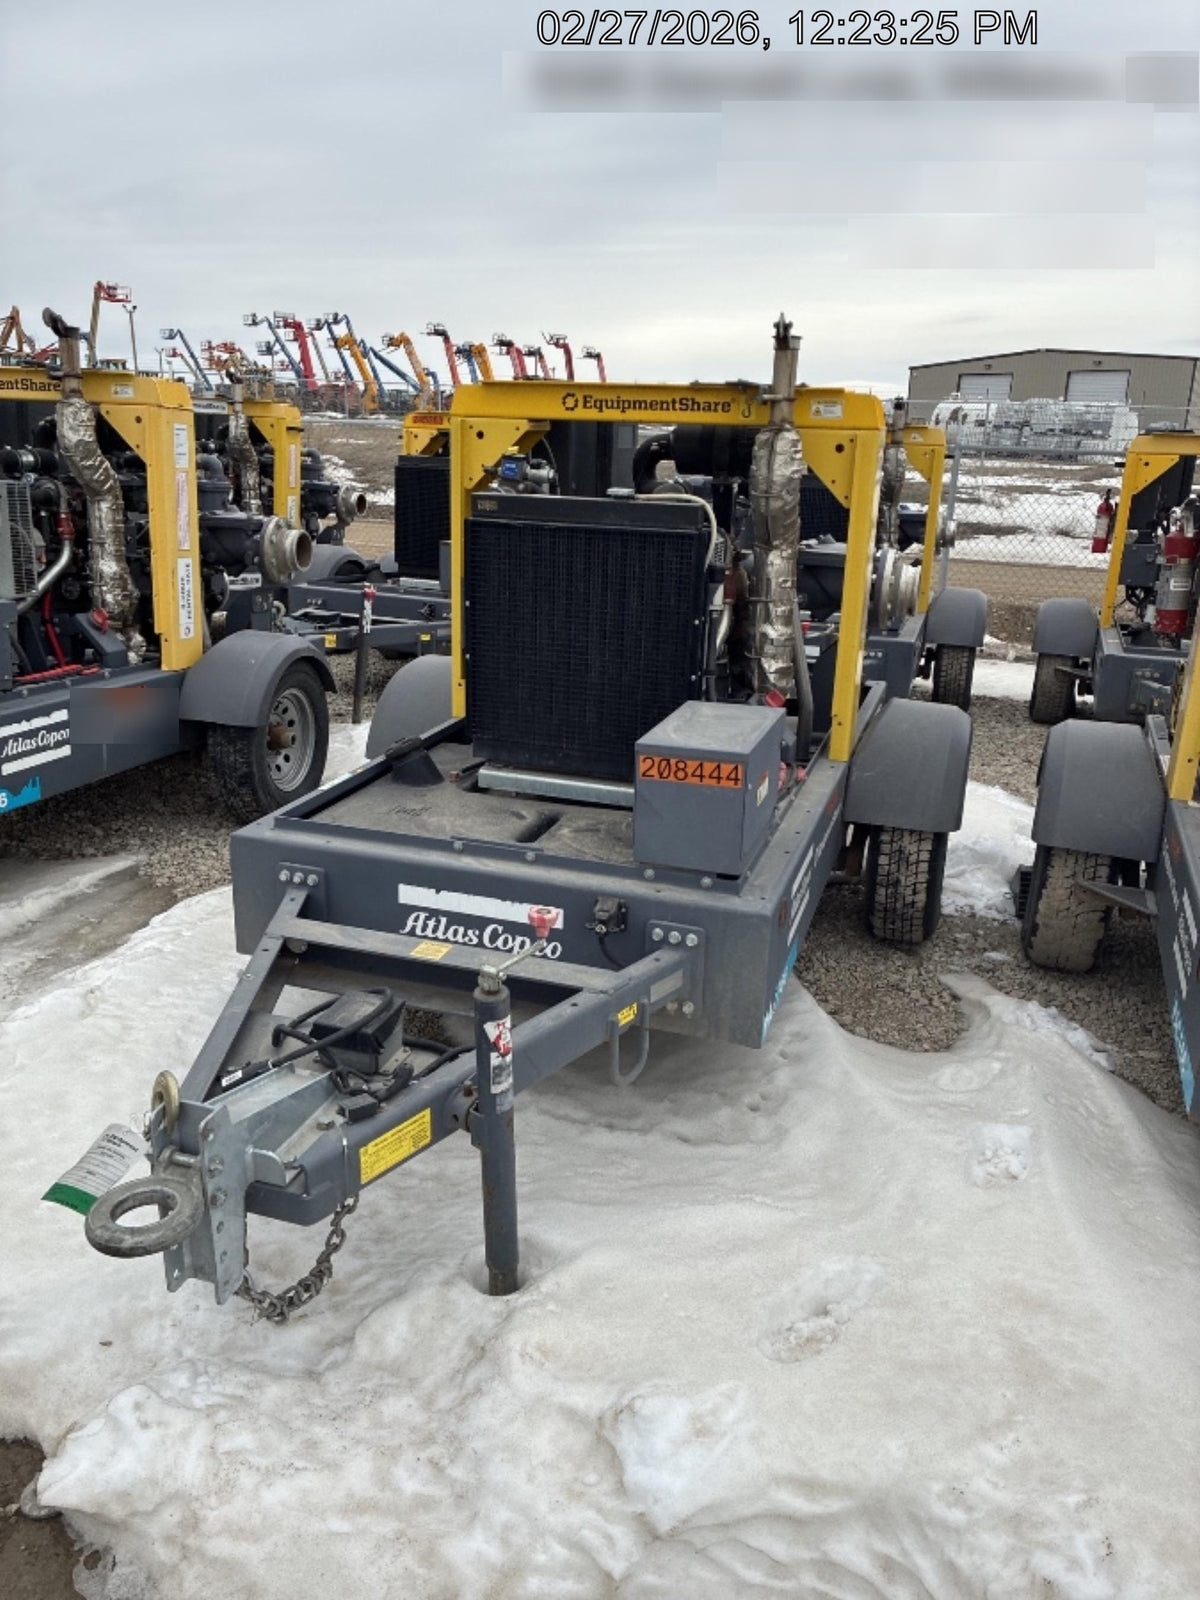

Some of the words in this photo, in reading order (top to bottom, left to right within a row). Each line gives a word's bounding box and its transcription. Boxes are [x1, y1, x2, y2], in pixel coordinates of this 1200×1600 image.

[582, 394, 732, 413] EquipmentShare
[0, 736, 38, 758] Atlas
[641, 756, 741, 786] 208444
[400, 911, 480, 945] Atlas
